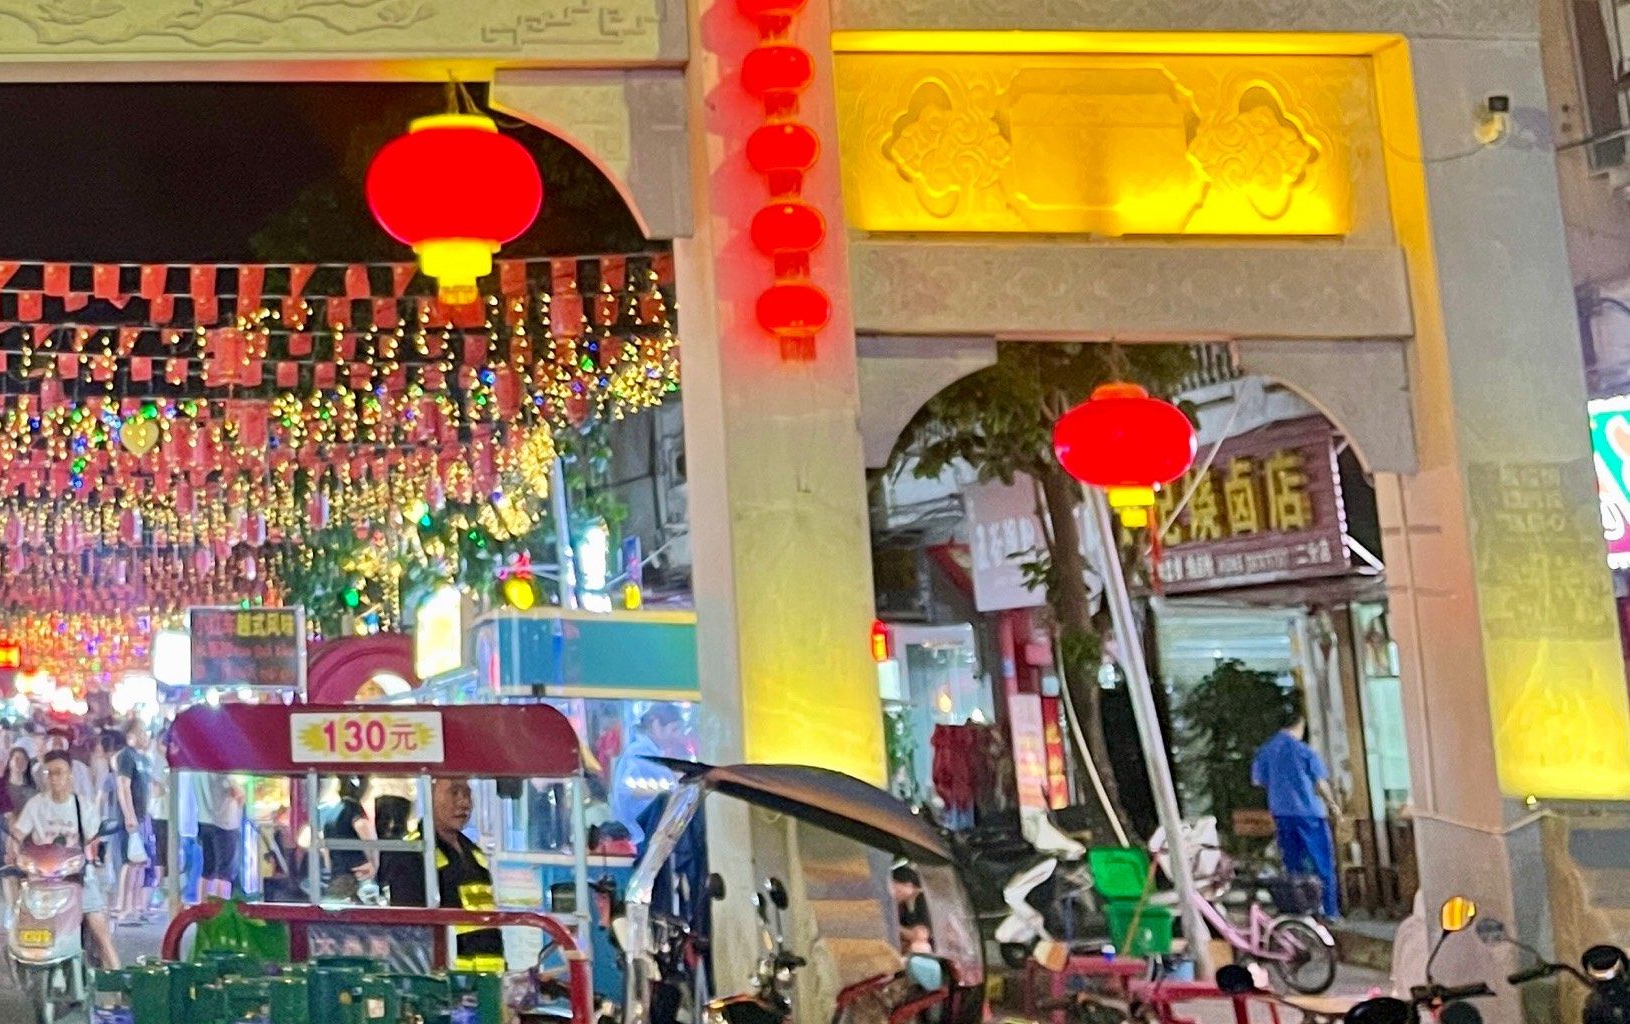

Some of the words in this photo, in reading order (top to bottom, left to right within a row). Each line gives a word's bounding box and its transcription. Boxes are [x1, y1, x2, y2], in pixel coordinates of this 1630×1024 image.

[1122, 449, 1314, 547] 记烧卤店
[323, 719, 418, 753] 130元
